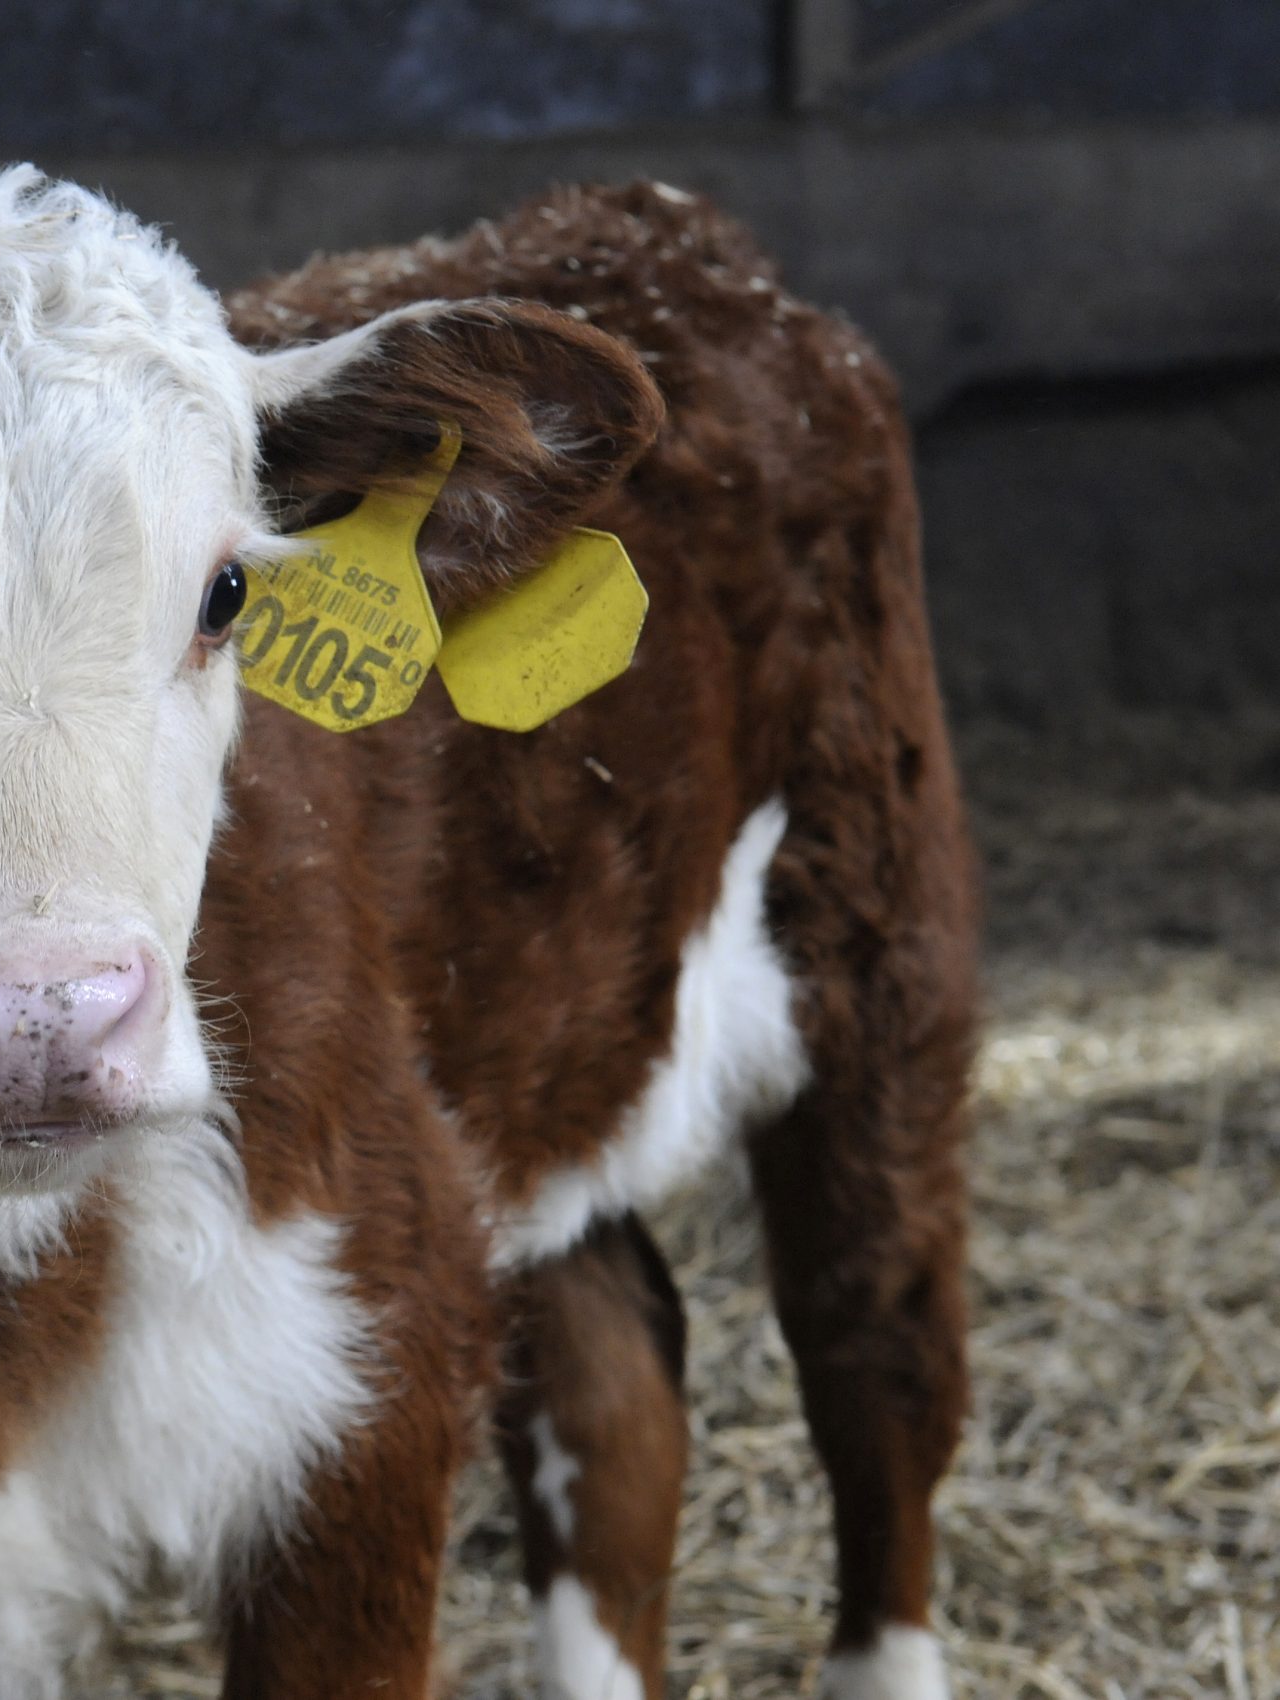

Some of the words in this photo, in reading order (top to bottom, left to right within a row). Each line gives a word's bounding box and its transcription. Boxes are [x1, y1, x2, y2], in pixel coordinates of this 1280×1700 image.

[307, 548, 337, 580] NL
[342, 566, 400, 606] 8675
[238, 595, 393, 720] 0105
